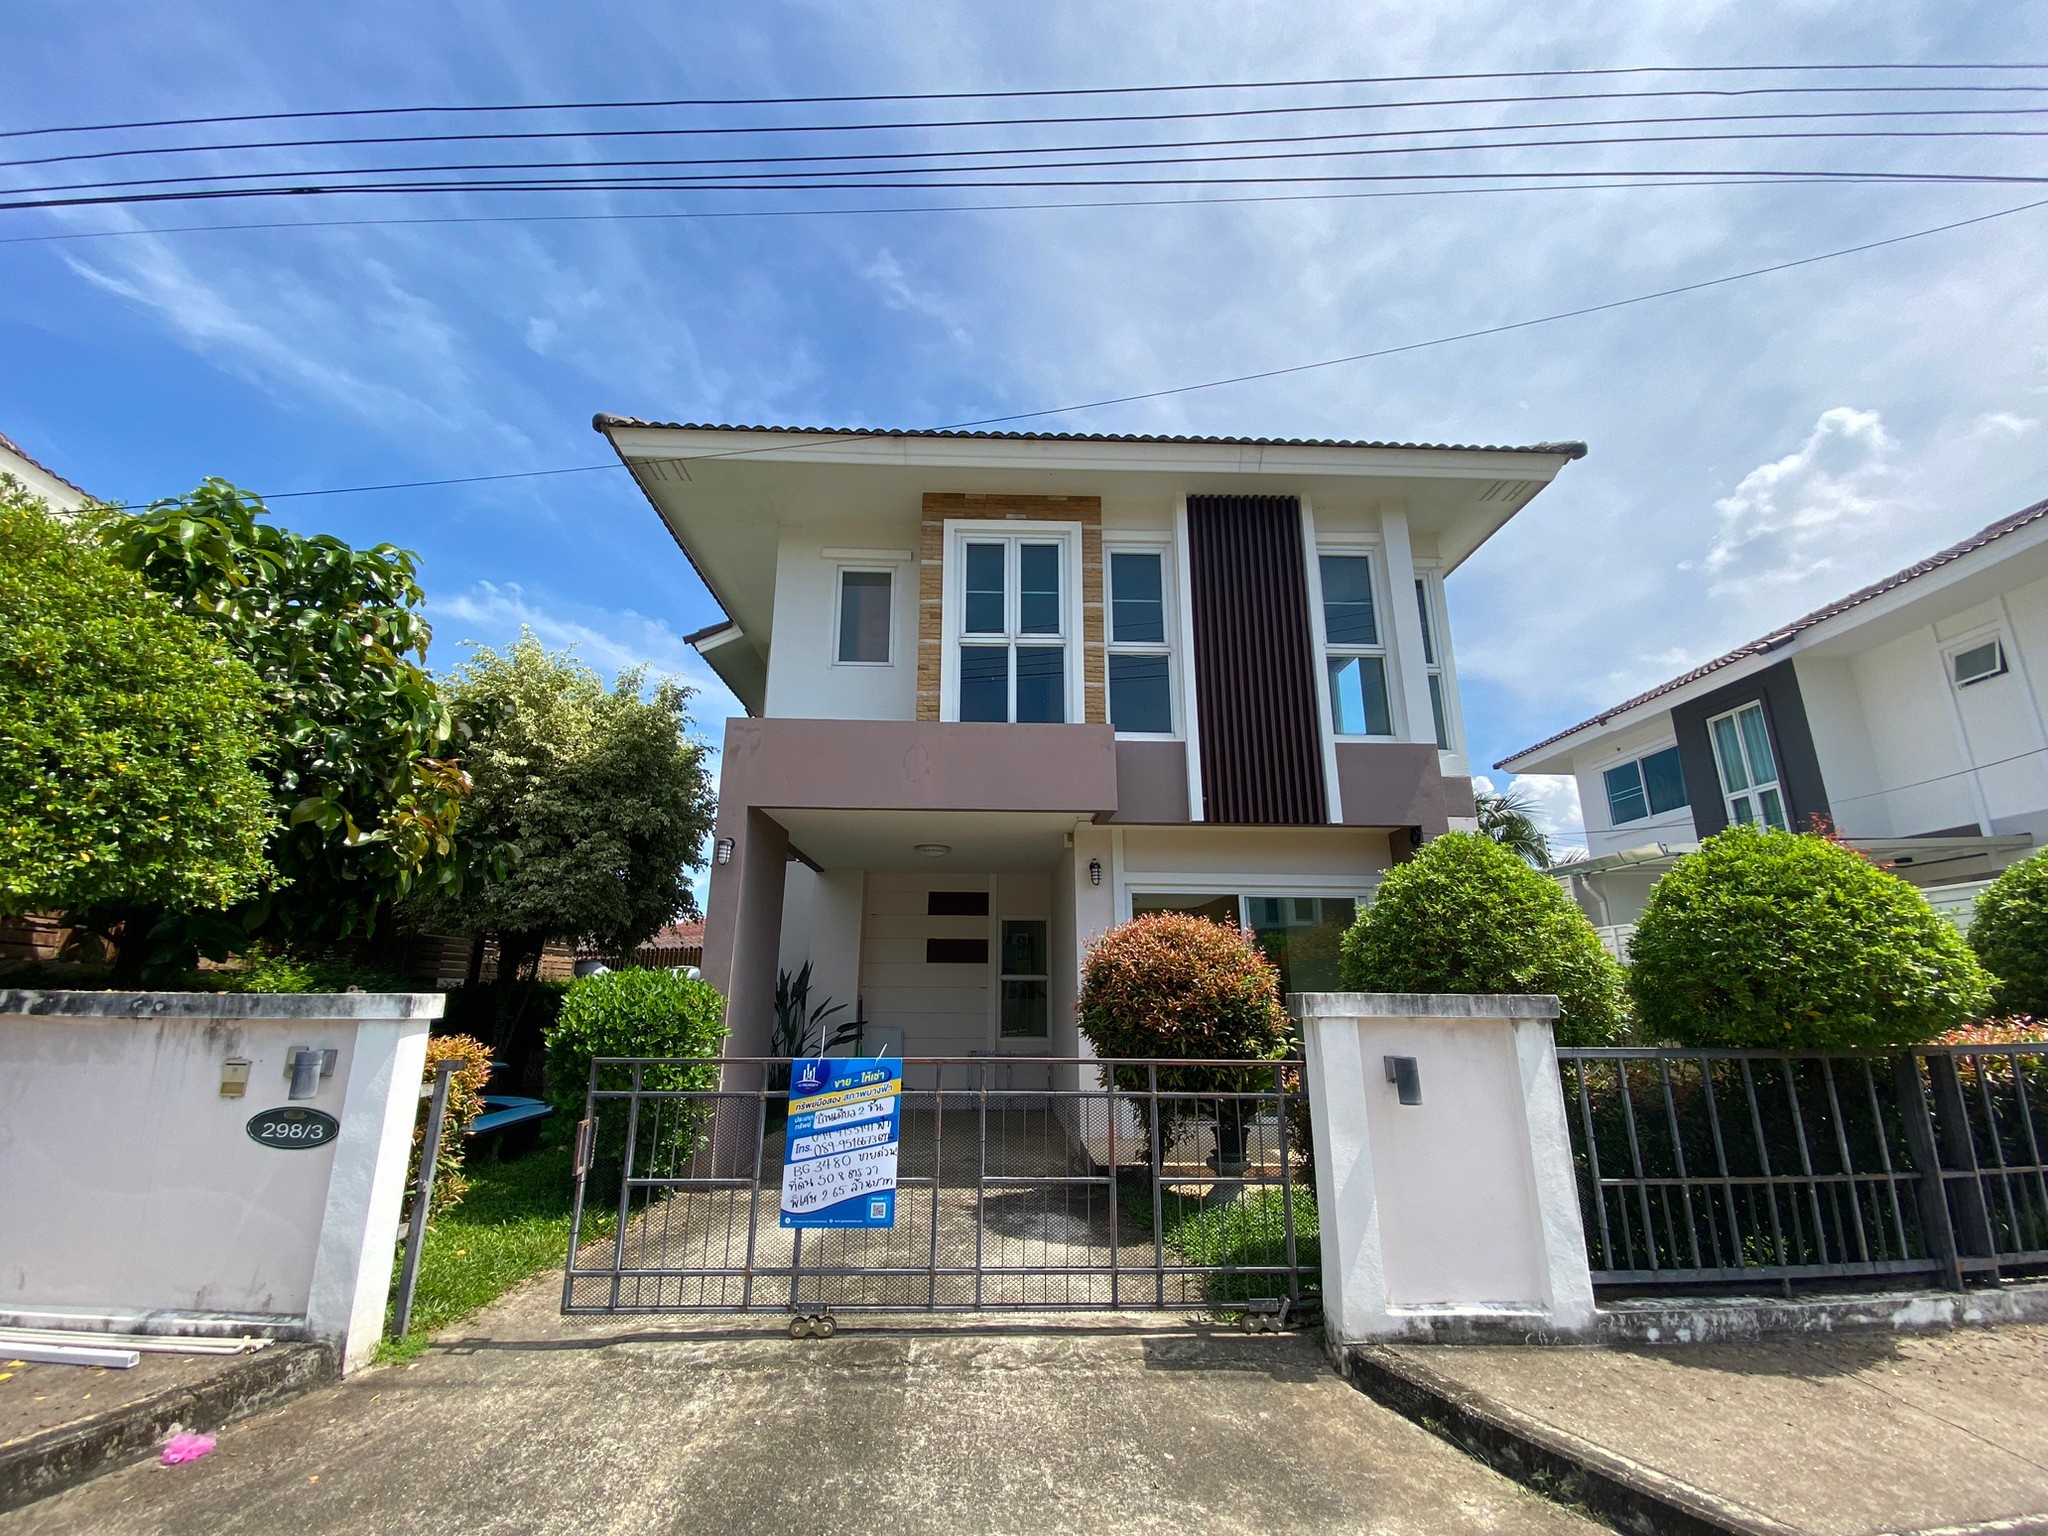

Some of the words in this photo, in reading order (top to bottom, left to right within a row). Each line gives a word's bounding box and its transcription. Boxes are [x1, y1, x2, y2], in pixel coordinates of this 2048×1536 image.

[834, 1079, 851, 1088] ขาย
[861, 1069, 885, 1083] ให้เช่า
[795, 1096, 840, 1112] ทรัพย์มือสอง
[858, 1106, 865, 1116] 2
[261, 1122, 323, 1138] 298/3
[793, 1164, 811, 1177] BG
